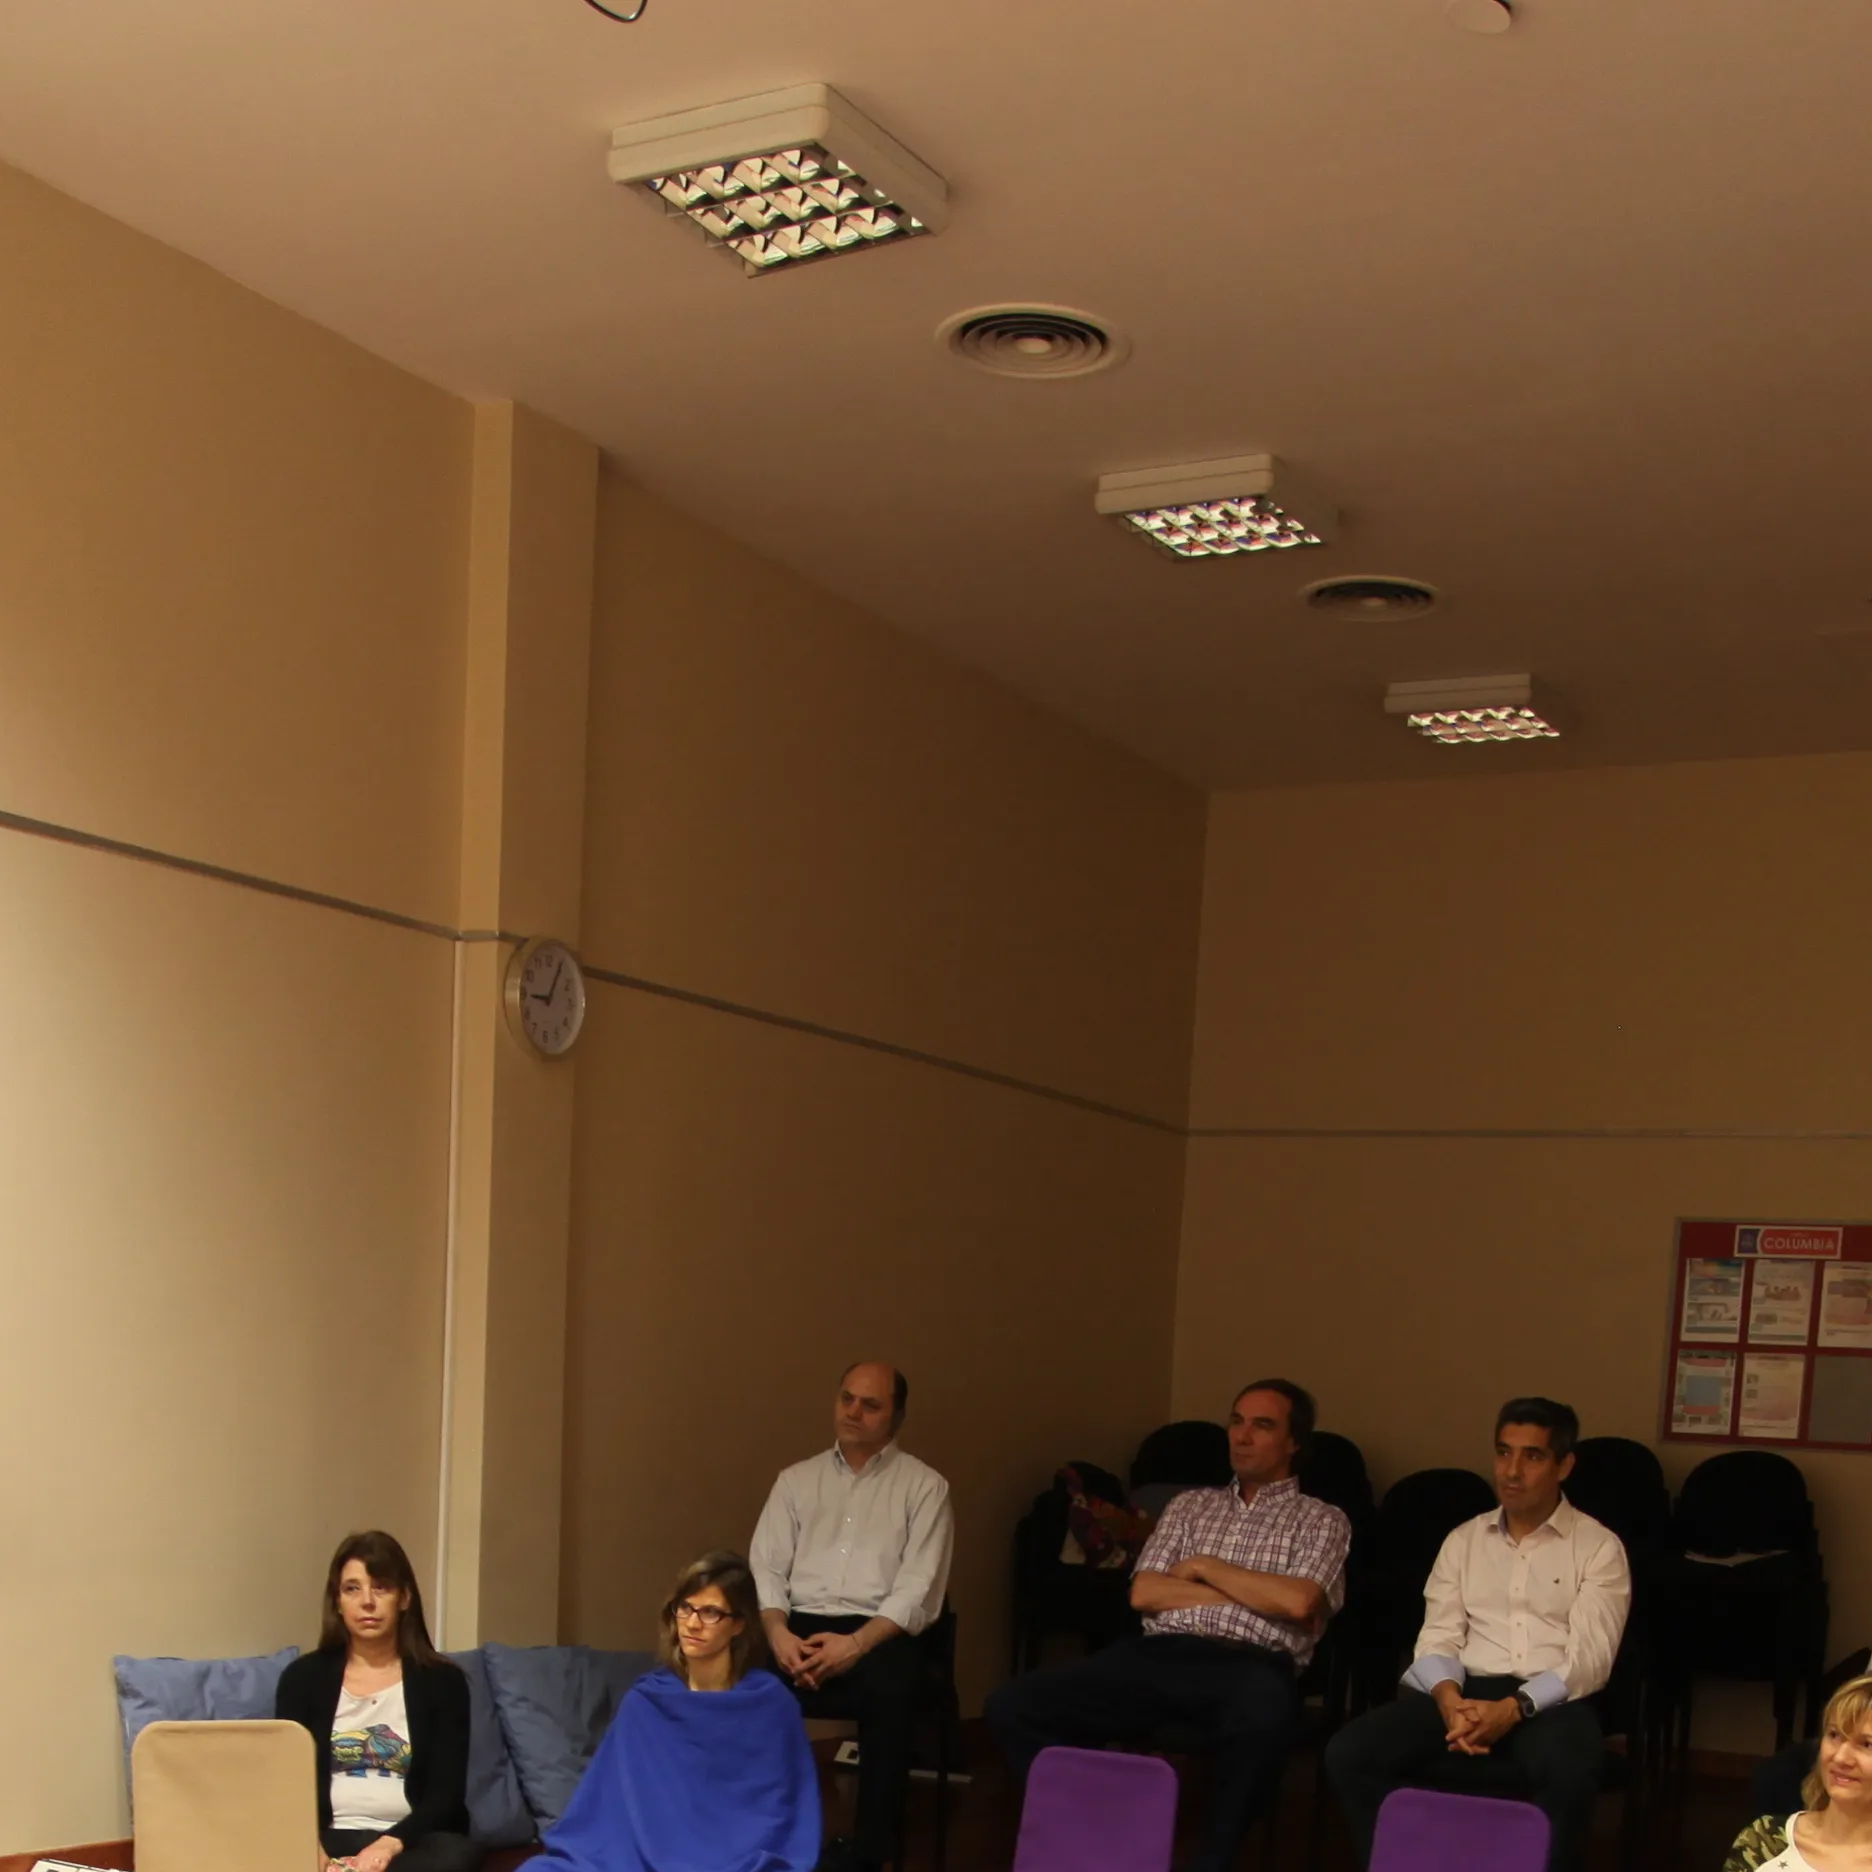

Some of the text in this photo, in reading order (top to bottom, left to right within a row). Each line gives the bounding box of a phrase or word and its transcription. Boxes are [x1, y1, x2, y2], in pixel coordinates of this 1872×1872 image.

[534, 957, 542, 969] 11
[542, 1030, 548, 1043] 6
[1763, 1237, 1835, 1251] COLUMBIA
